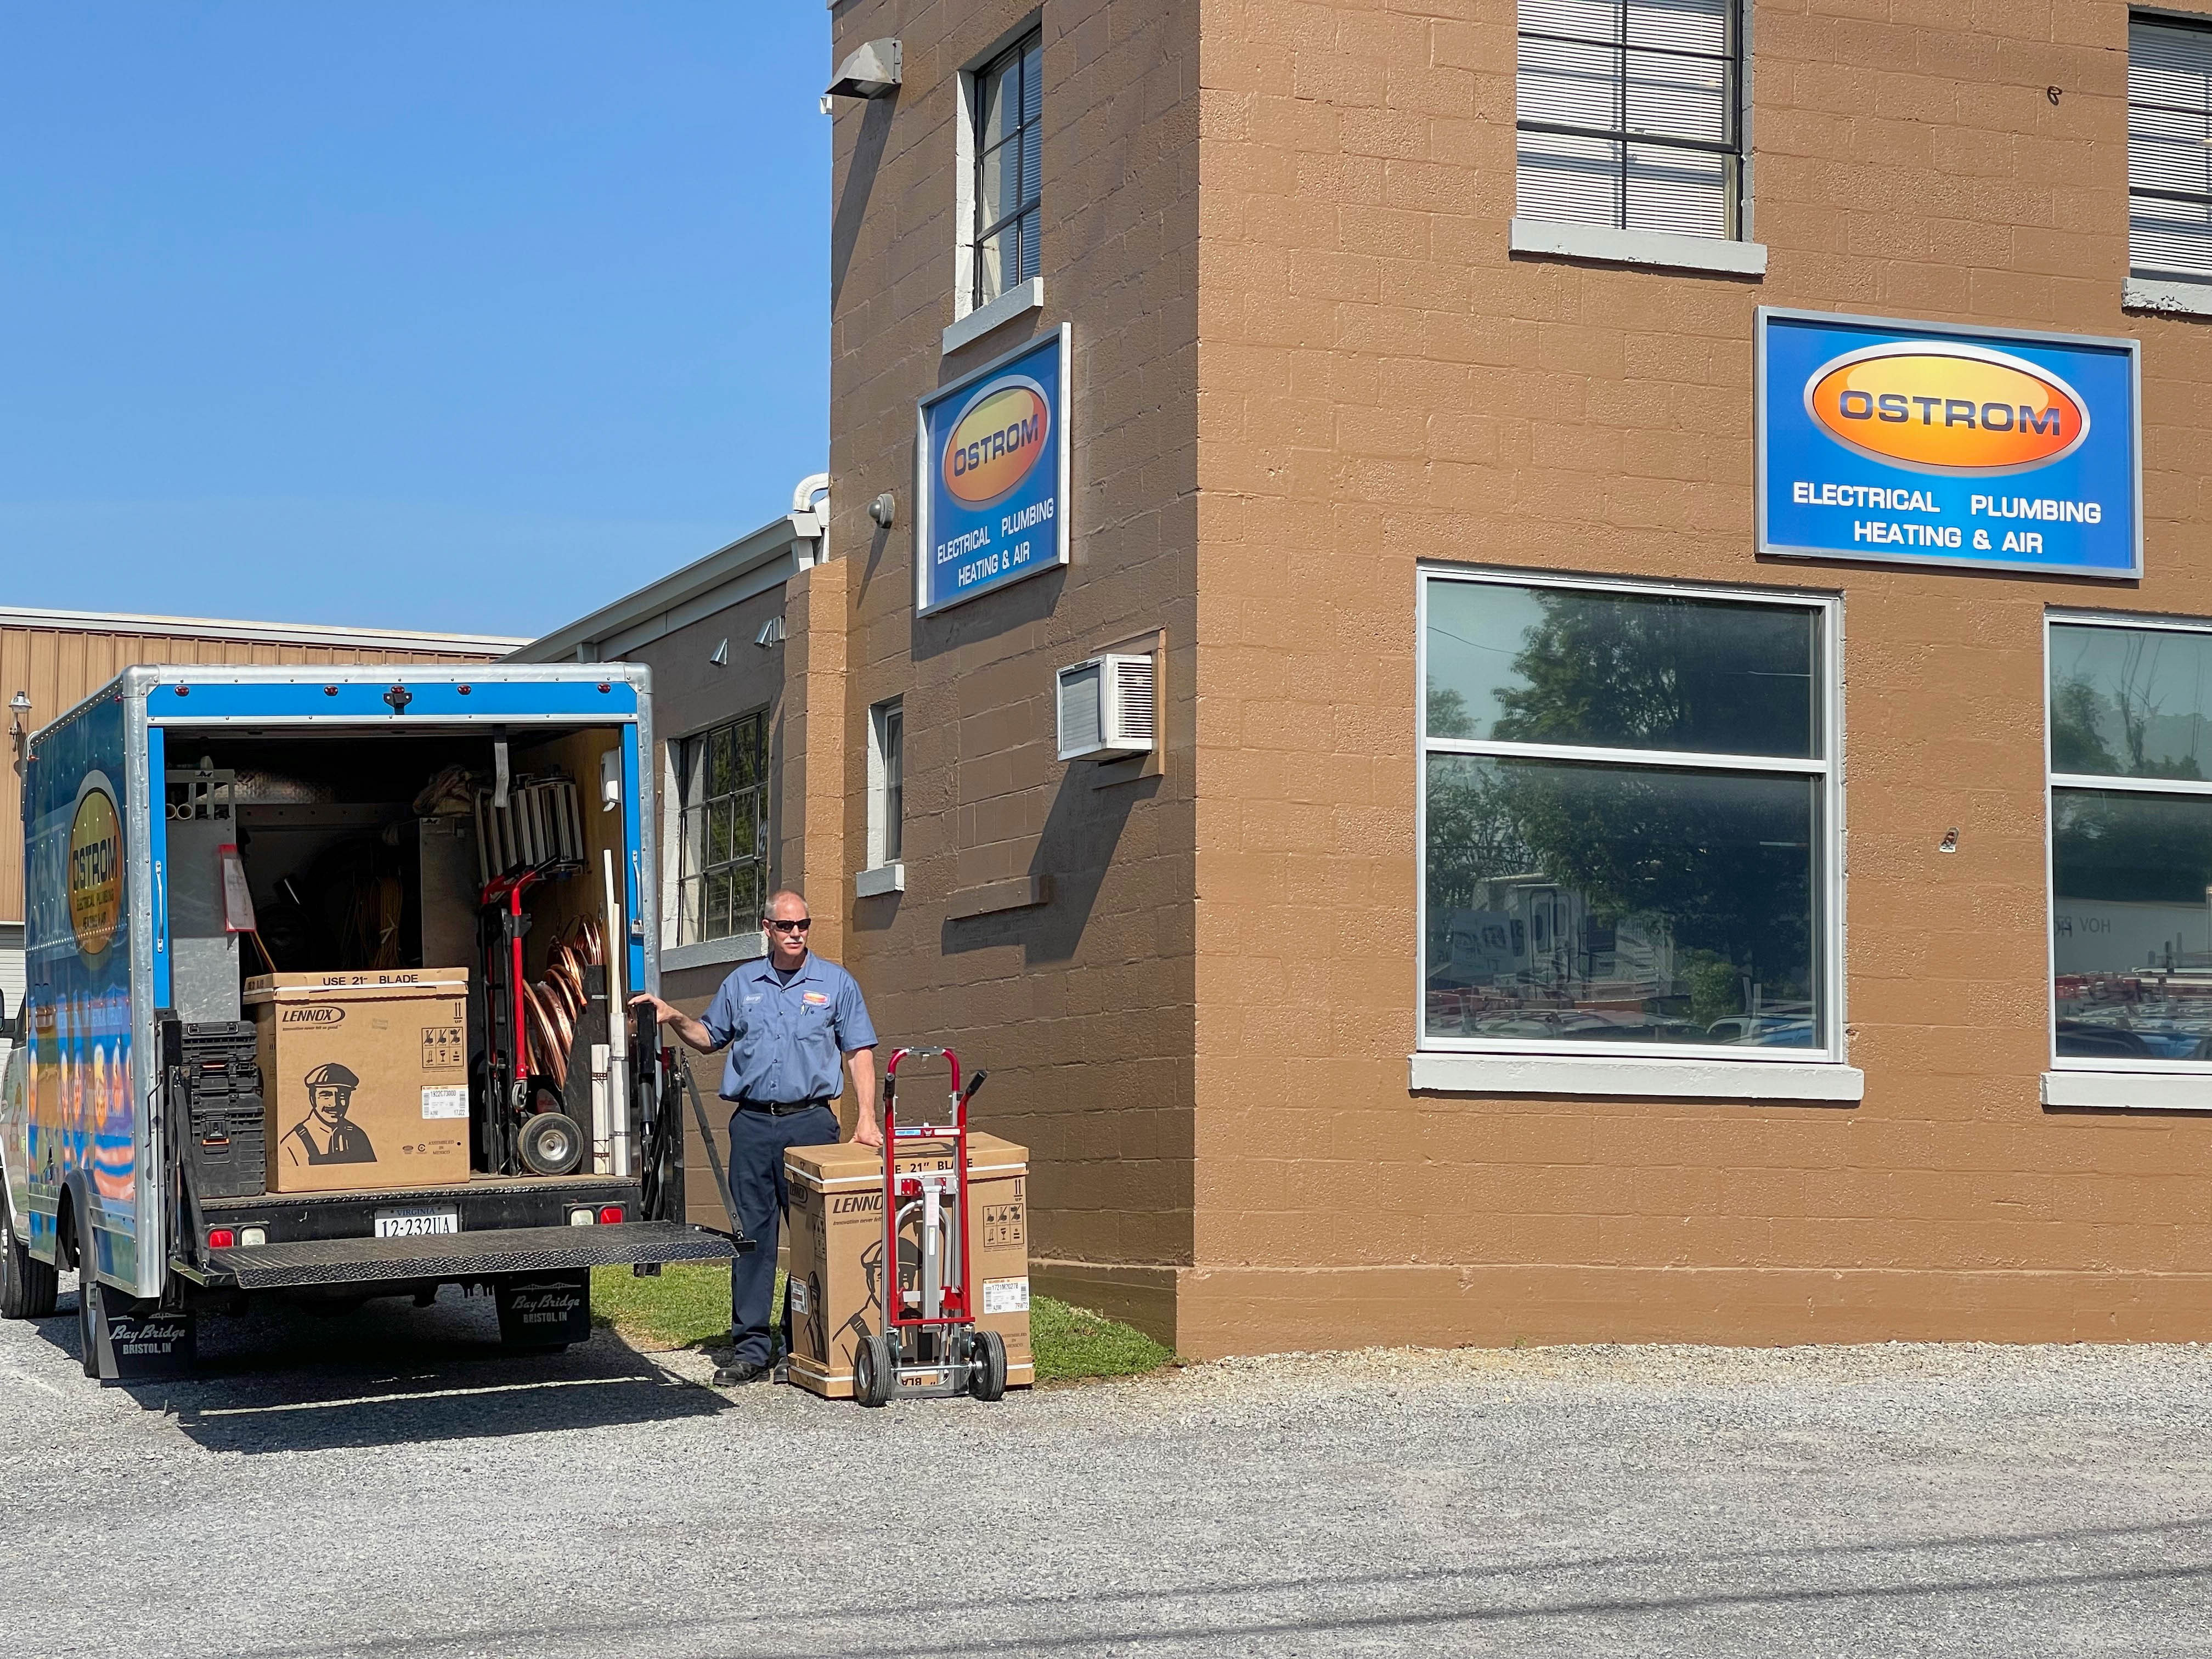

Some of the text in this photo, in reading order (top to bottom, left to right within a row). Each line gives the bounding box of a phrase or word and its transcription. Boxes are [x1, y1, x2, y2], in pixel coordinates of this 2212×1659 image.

[1839, 391, 2060, 436] OSTROM
[953, 414, 1038, 477] OSTROM
[1793, 482, 2102, 524] ELECTRICAL PLUMBING
[938, 498, 1054, 565] ELECTRICAL PLUMBING
[1854, 520, 2043, 554] HEATING & AIR
[958, 541, 1030, 588] HEATING & AIR
[73, 835, 117, 890] OSTROM
[323, 977, 346, 986] USE
[379, 974, 419, 984] BLADE
[282, 1009, 333, 1022] LENNOX
[910, 1162, 929, 1172] 21"
[938, 1158, 973, 1171] BLE
[833, 1195, 882, 1214] LENNO
[382, 1217, 450, 1237] 12-232UA
[511, 1294, 579, 1312] Bay Bridge
[559, 1312, 567, 1321] IN
[110, 1324, 185, 1344] Bay Bridge
[123, 1342, 171, 1355] BRISTOL, IN
